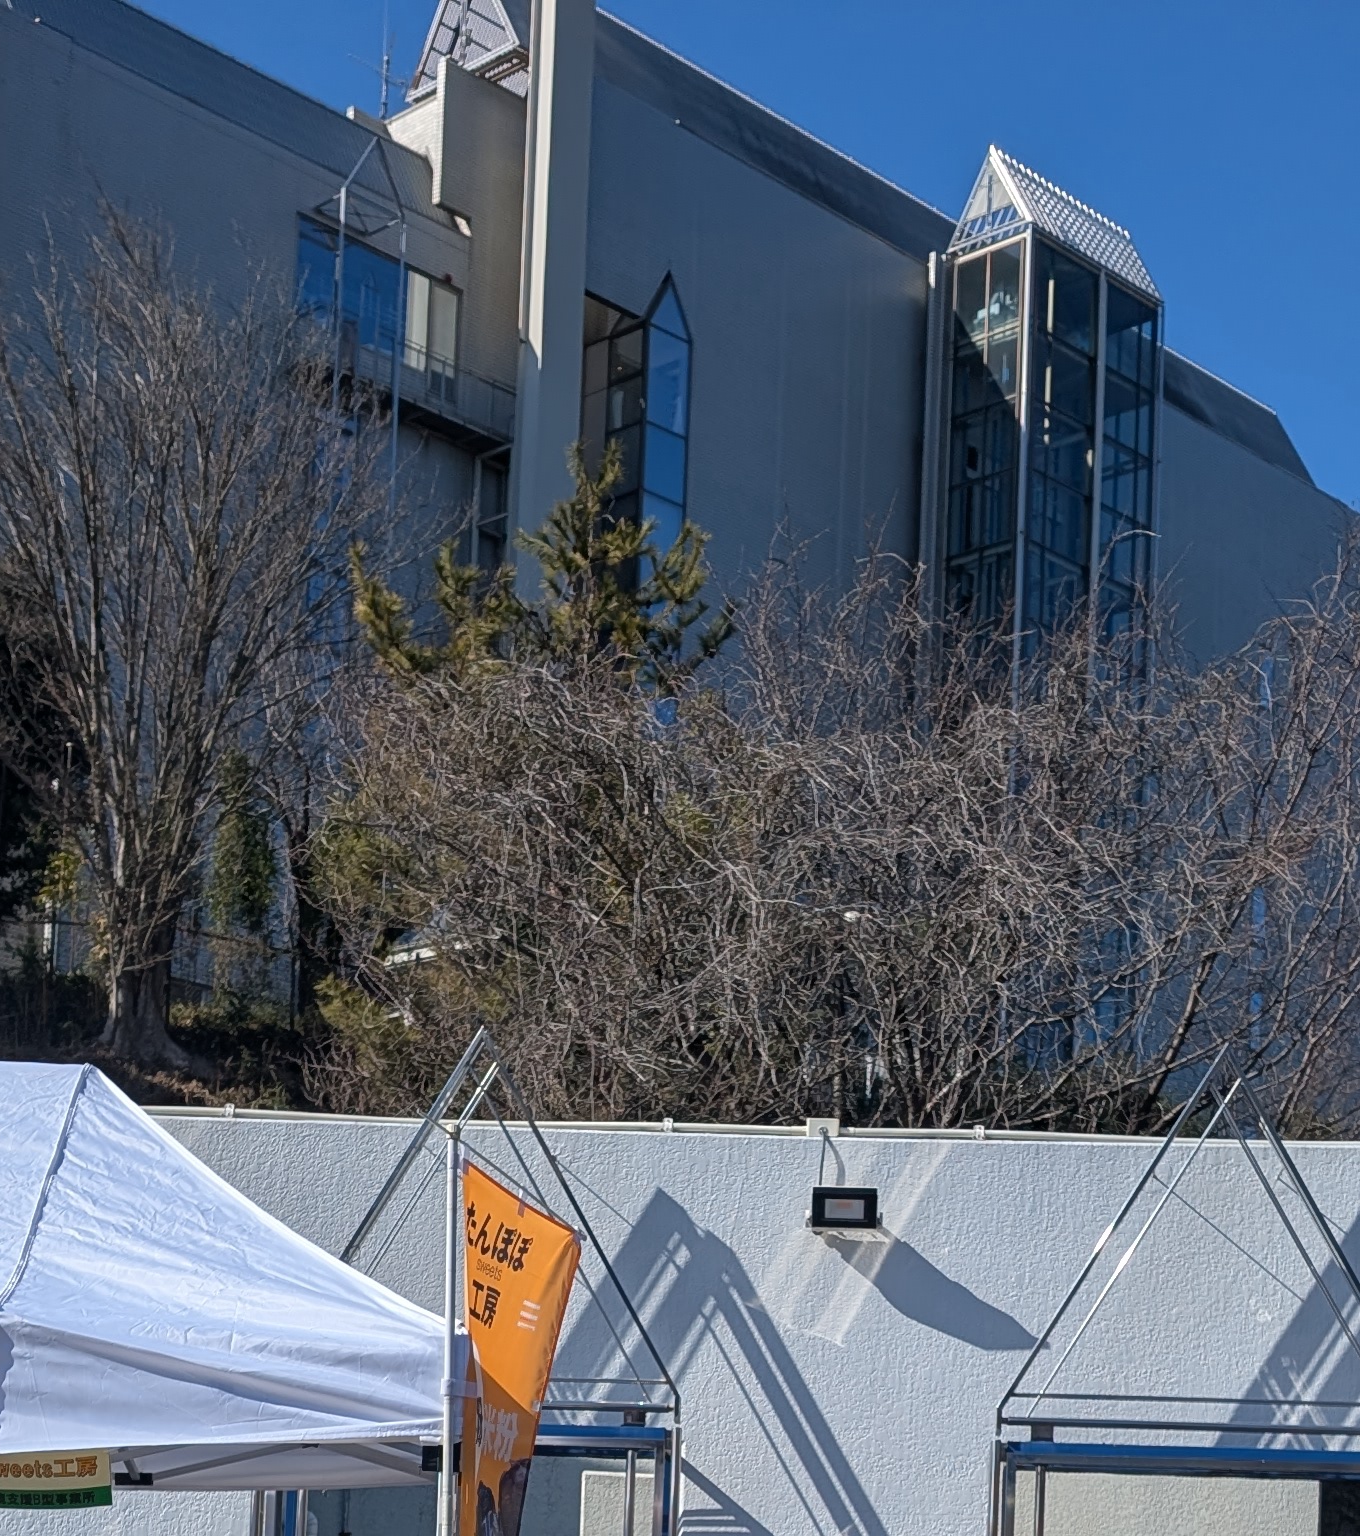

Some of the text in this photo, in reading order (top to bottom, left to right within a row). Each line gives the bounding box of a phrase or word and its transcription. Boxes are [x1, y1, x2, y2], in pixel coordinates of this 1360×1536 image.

[466, 1200, 533, 1272] たんぽぽ
[476, 1258, 503, 1281] sweets
[469, 1279, 501, 1329] 工房
